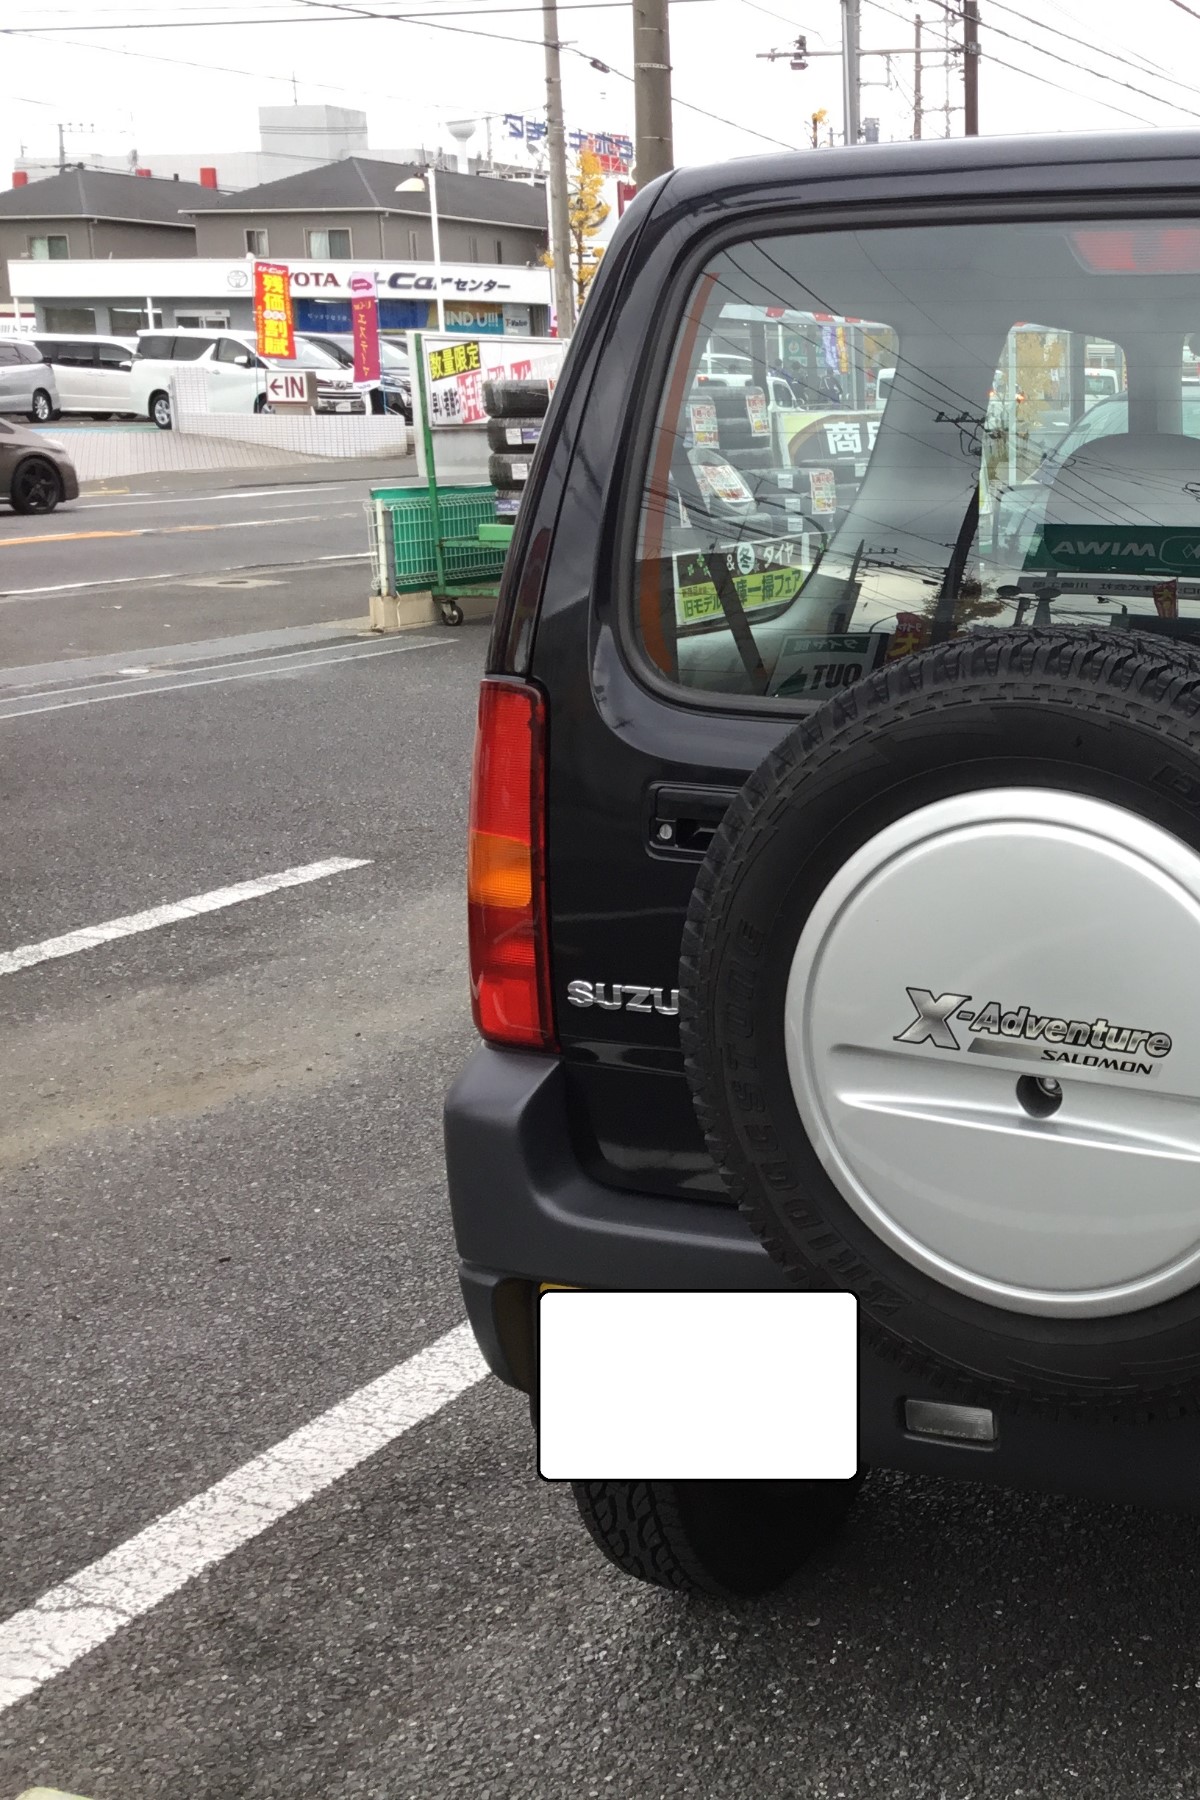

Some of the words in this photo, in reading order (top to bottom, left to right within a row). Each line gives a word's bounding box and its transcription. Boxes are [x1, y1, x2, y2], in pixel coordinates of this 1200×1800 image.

[445, 310, 473, 326] IND
[429, 342, 481, 379] 数量限定
[285, 376, 305, 399] IN
[566, 979, 680, 1016] SUZU
[893, 986, 1172, 1058] X-Adventure
[1040, 1049, 1154, 1075] SALOMON
[725, 918, 912, 1317] BRIDGESTONE
